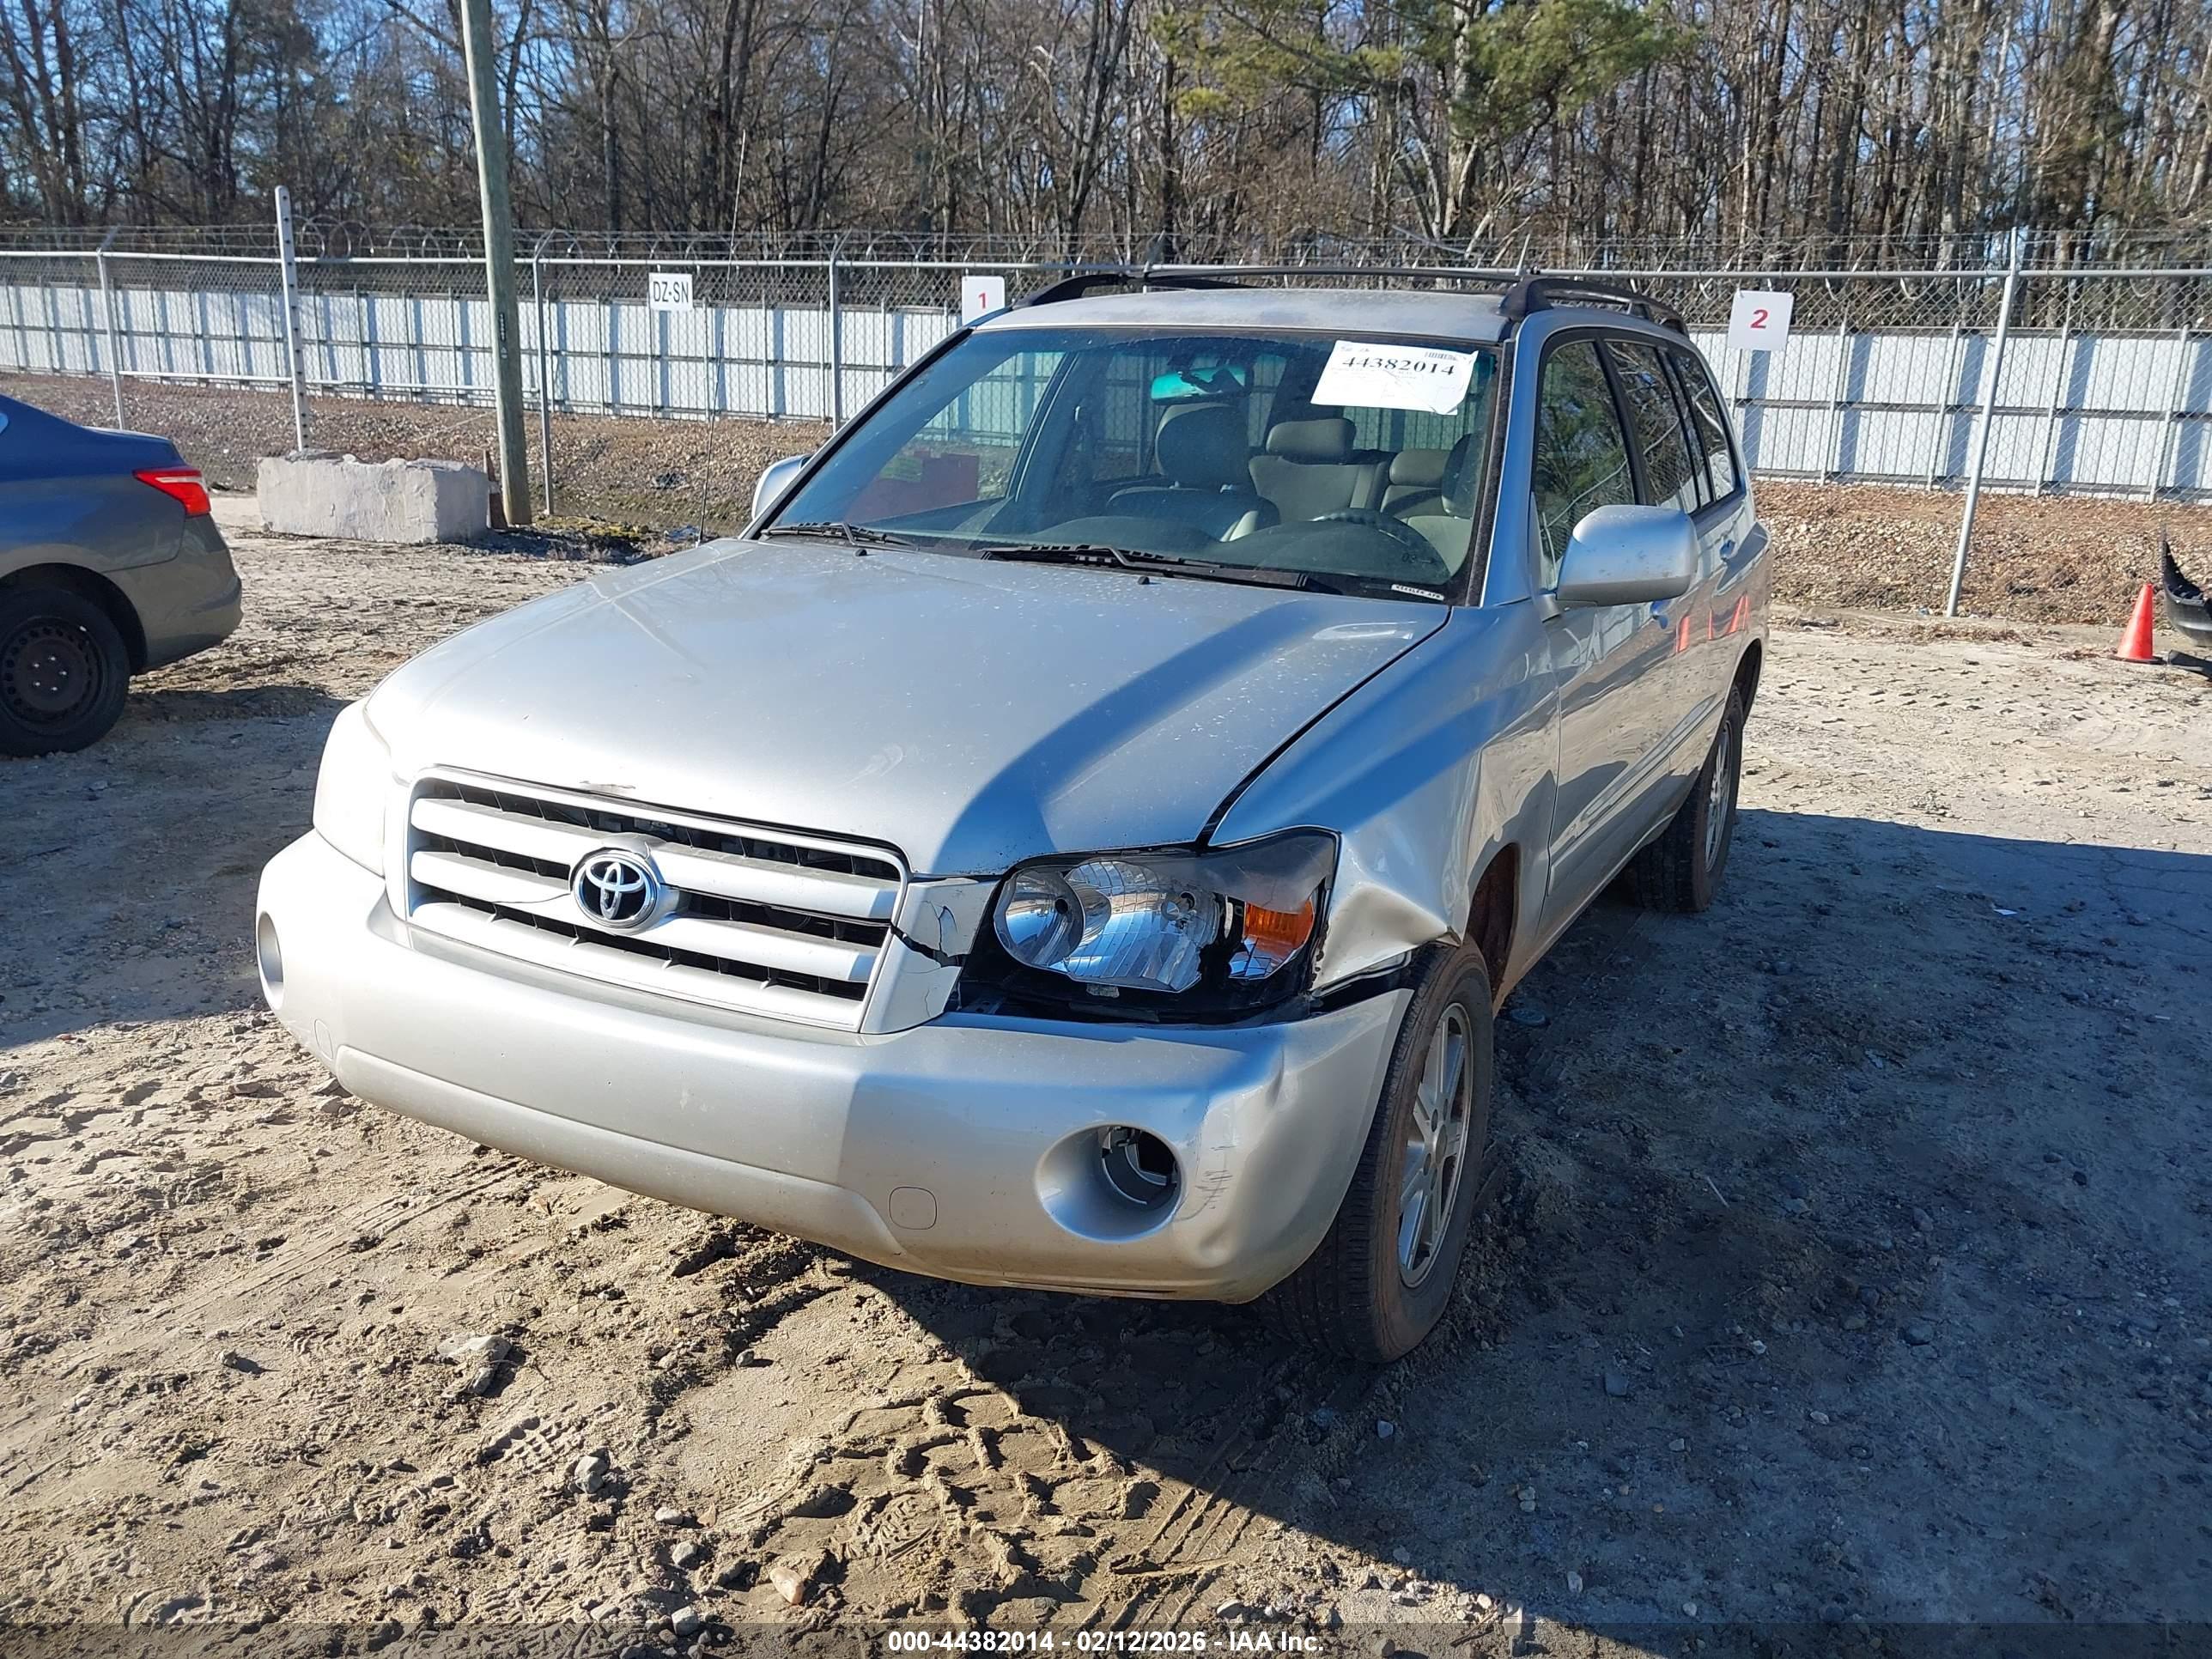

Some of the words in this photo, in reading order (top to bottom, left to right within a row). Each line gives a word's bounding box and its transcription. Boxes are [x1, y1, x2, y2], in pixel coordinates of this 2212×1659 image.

[653, 281, 689, 303] DZ-SN
[978, 292, 986, 309] 1
[1750, 308, 1769, 329] 2
[1342, 356, 1455, 376] 44382014
